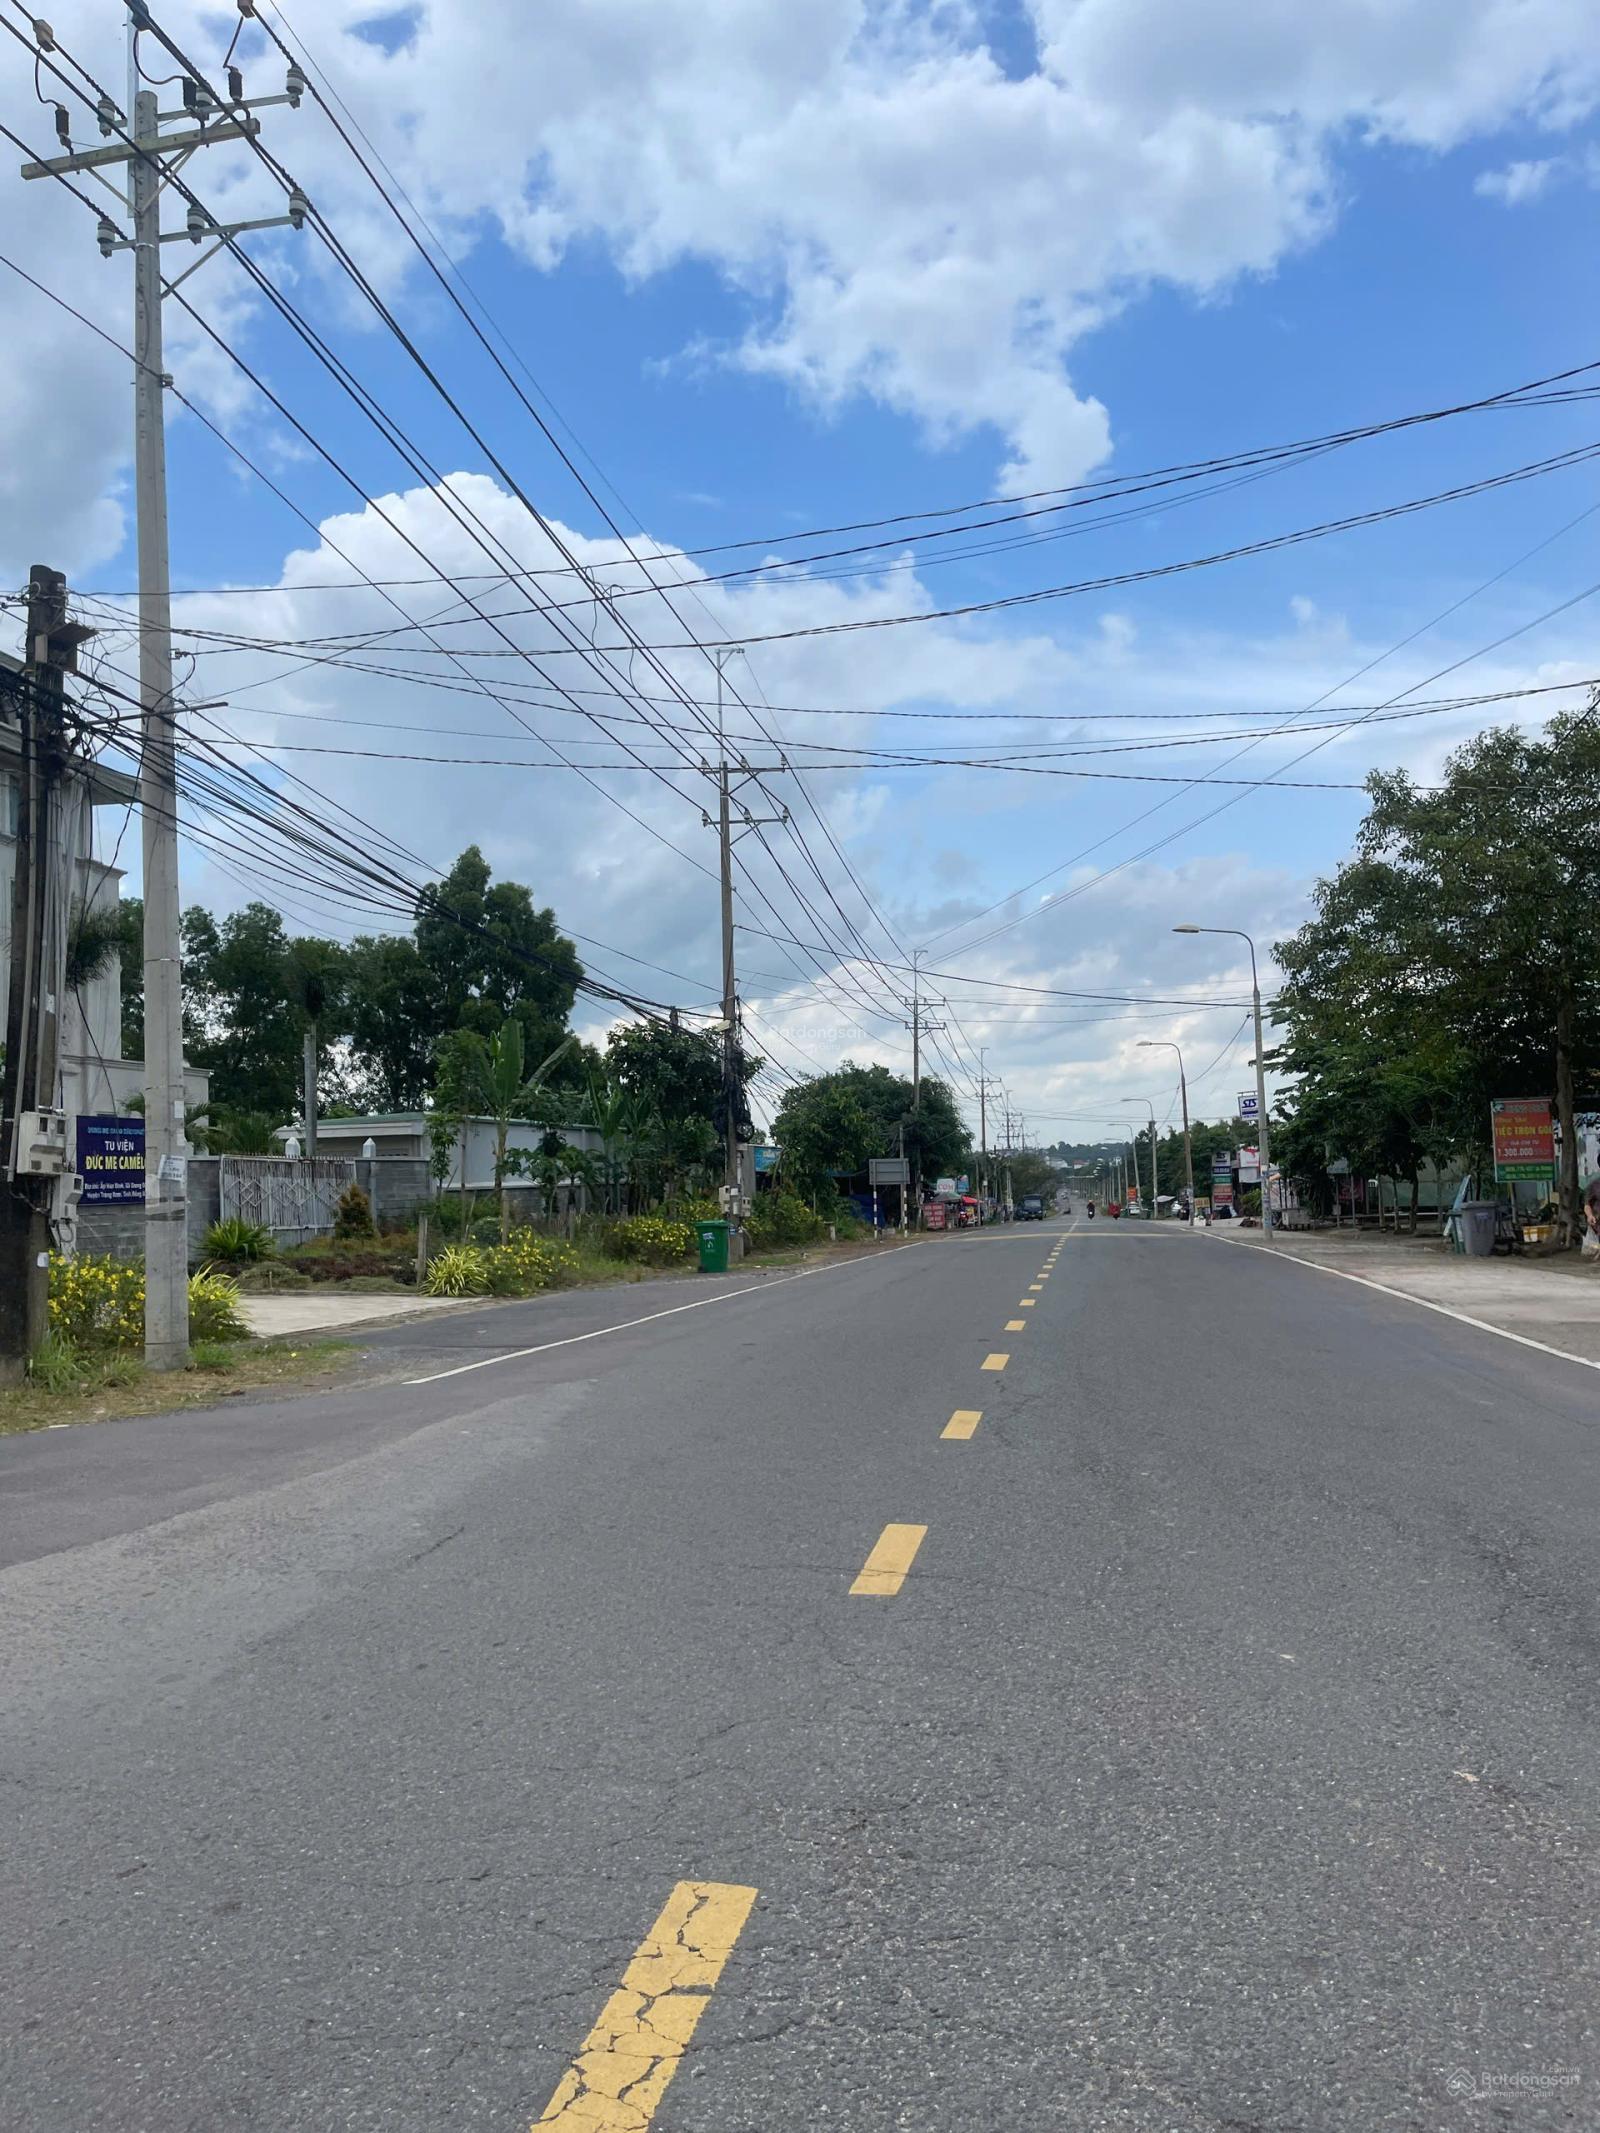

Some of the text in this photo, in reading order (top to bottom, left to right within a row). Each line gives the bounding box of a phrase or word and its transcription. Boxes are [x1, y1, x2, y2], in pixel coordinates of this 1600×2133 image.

[105, 1138, 134, 1153] TU VIỆN
[85, 1154, 104, 1170] ĐỨC
[105, 1155, 117, 1172] MẸ
[119, 1152, 145, 1170] CAMÊL
